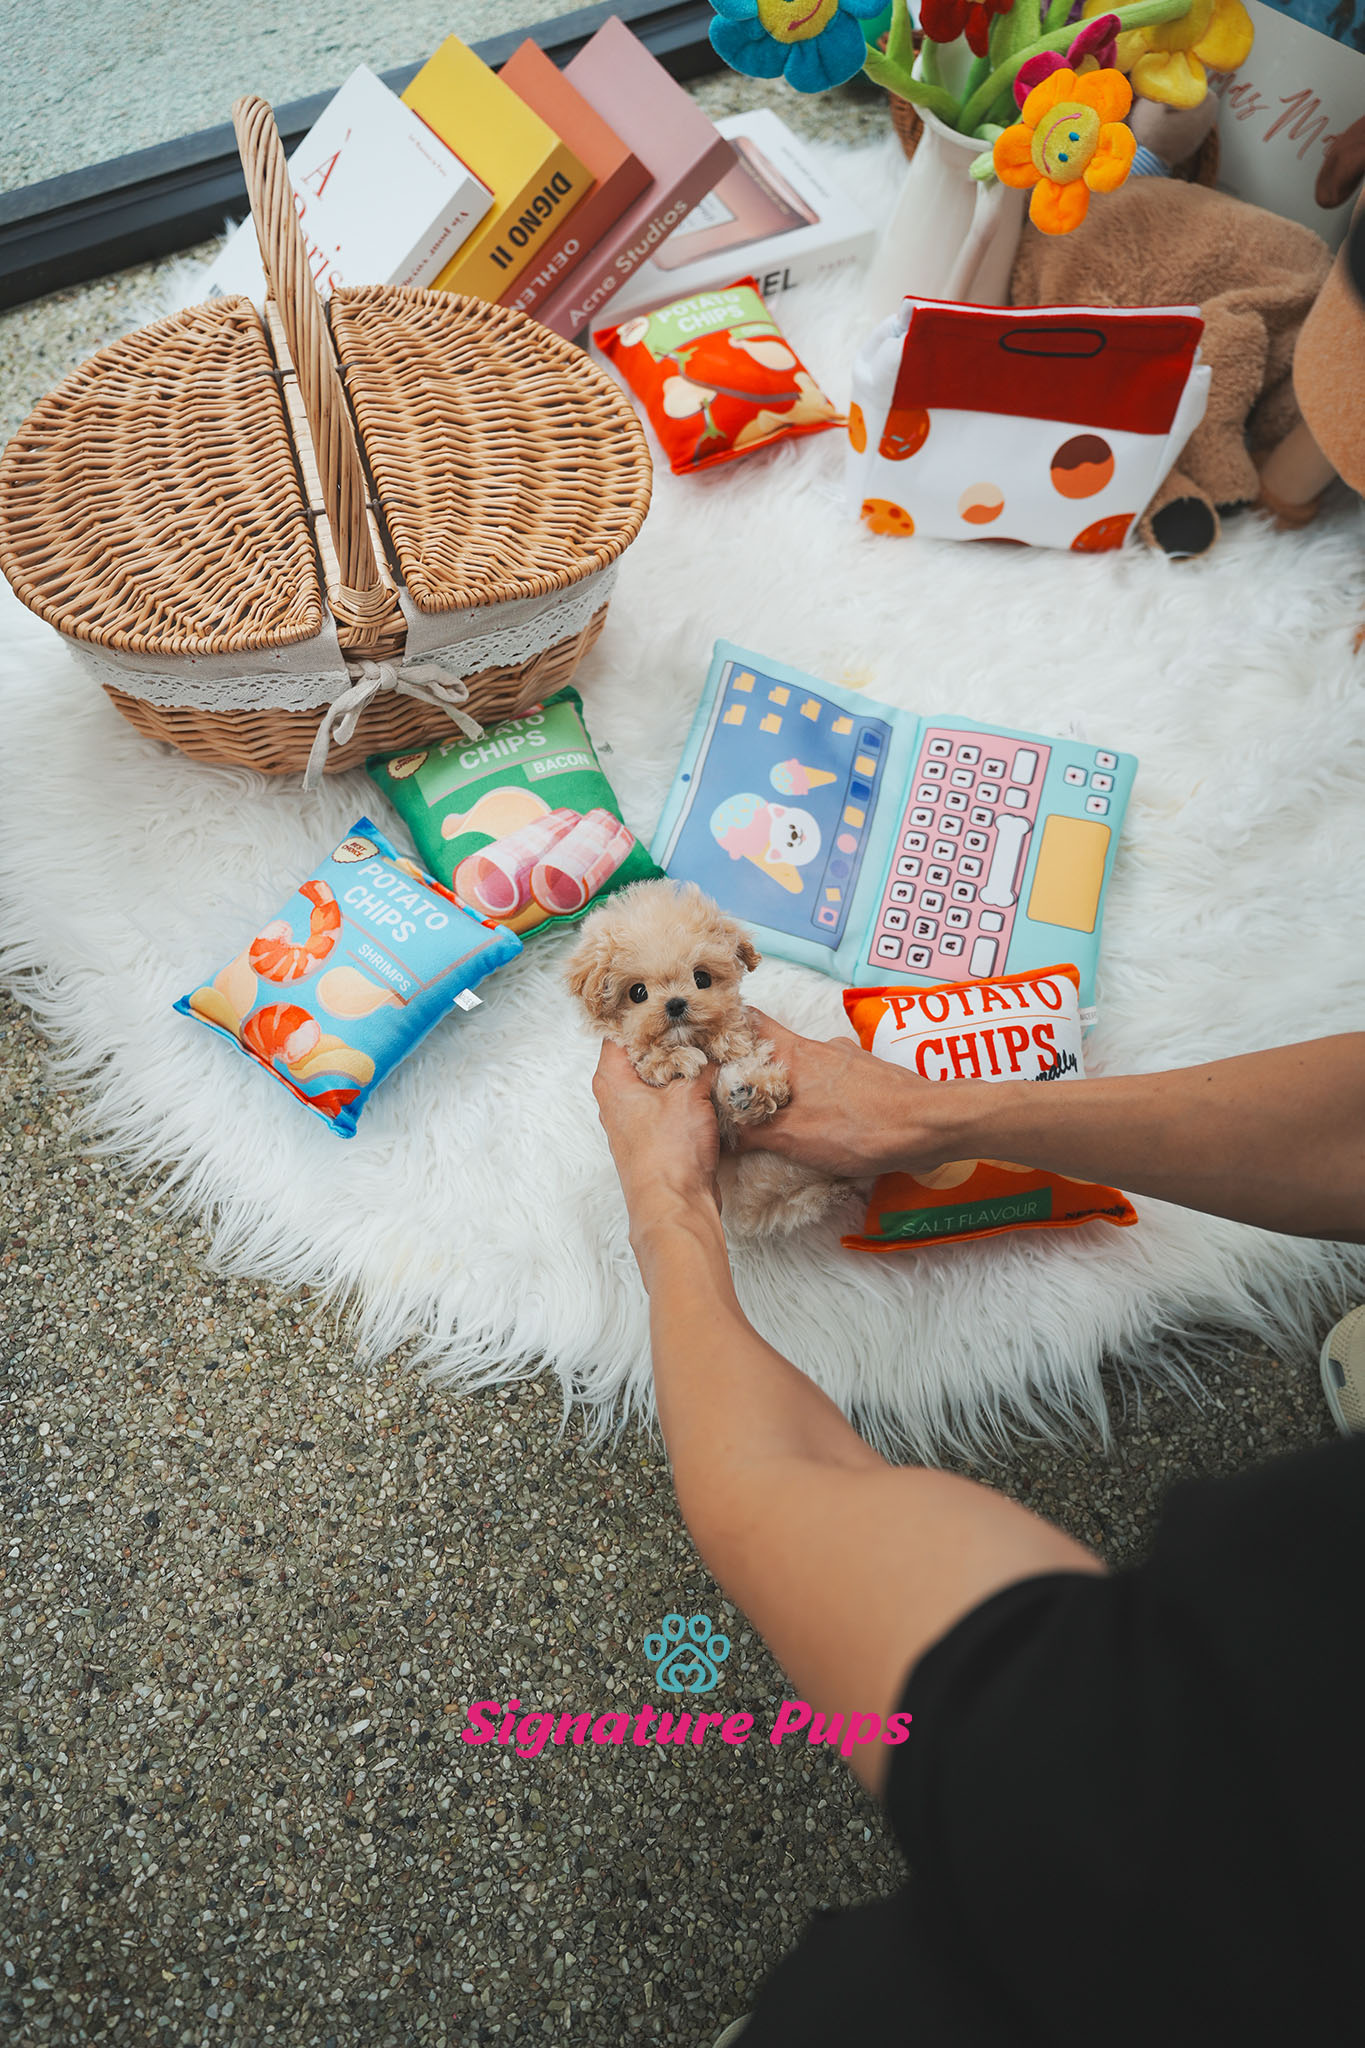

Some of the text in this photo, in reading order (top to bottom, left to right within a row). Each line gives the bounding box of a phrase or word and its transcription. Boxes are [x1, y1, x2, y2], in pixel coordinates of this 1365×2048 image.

[489, 171, 573, 270] DIGNO II
[569, 201, 688, 328] Acne Studios
[678, 304, 745, 333] CHIPS
[437, 714, 545, 757] POATO
[458, 729, 547, 770] CHIPS
[532, 753, 591, 775] BACON
[343, 885, 417, 943] CHIPS
[357, 862, 450, 931] POTATO
[357, 943, 412, 993] SHRIMPS
[882, 979, 1063, 1031] POTATO
[914, 1022, 1059, 1082] CHIPS
[901, 1216, 954, 1237] SALT
[959, 1200, 1039, 1228] FLAVOUR
